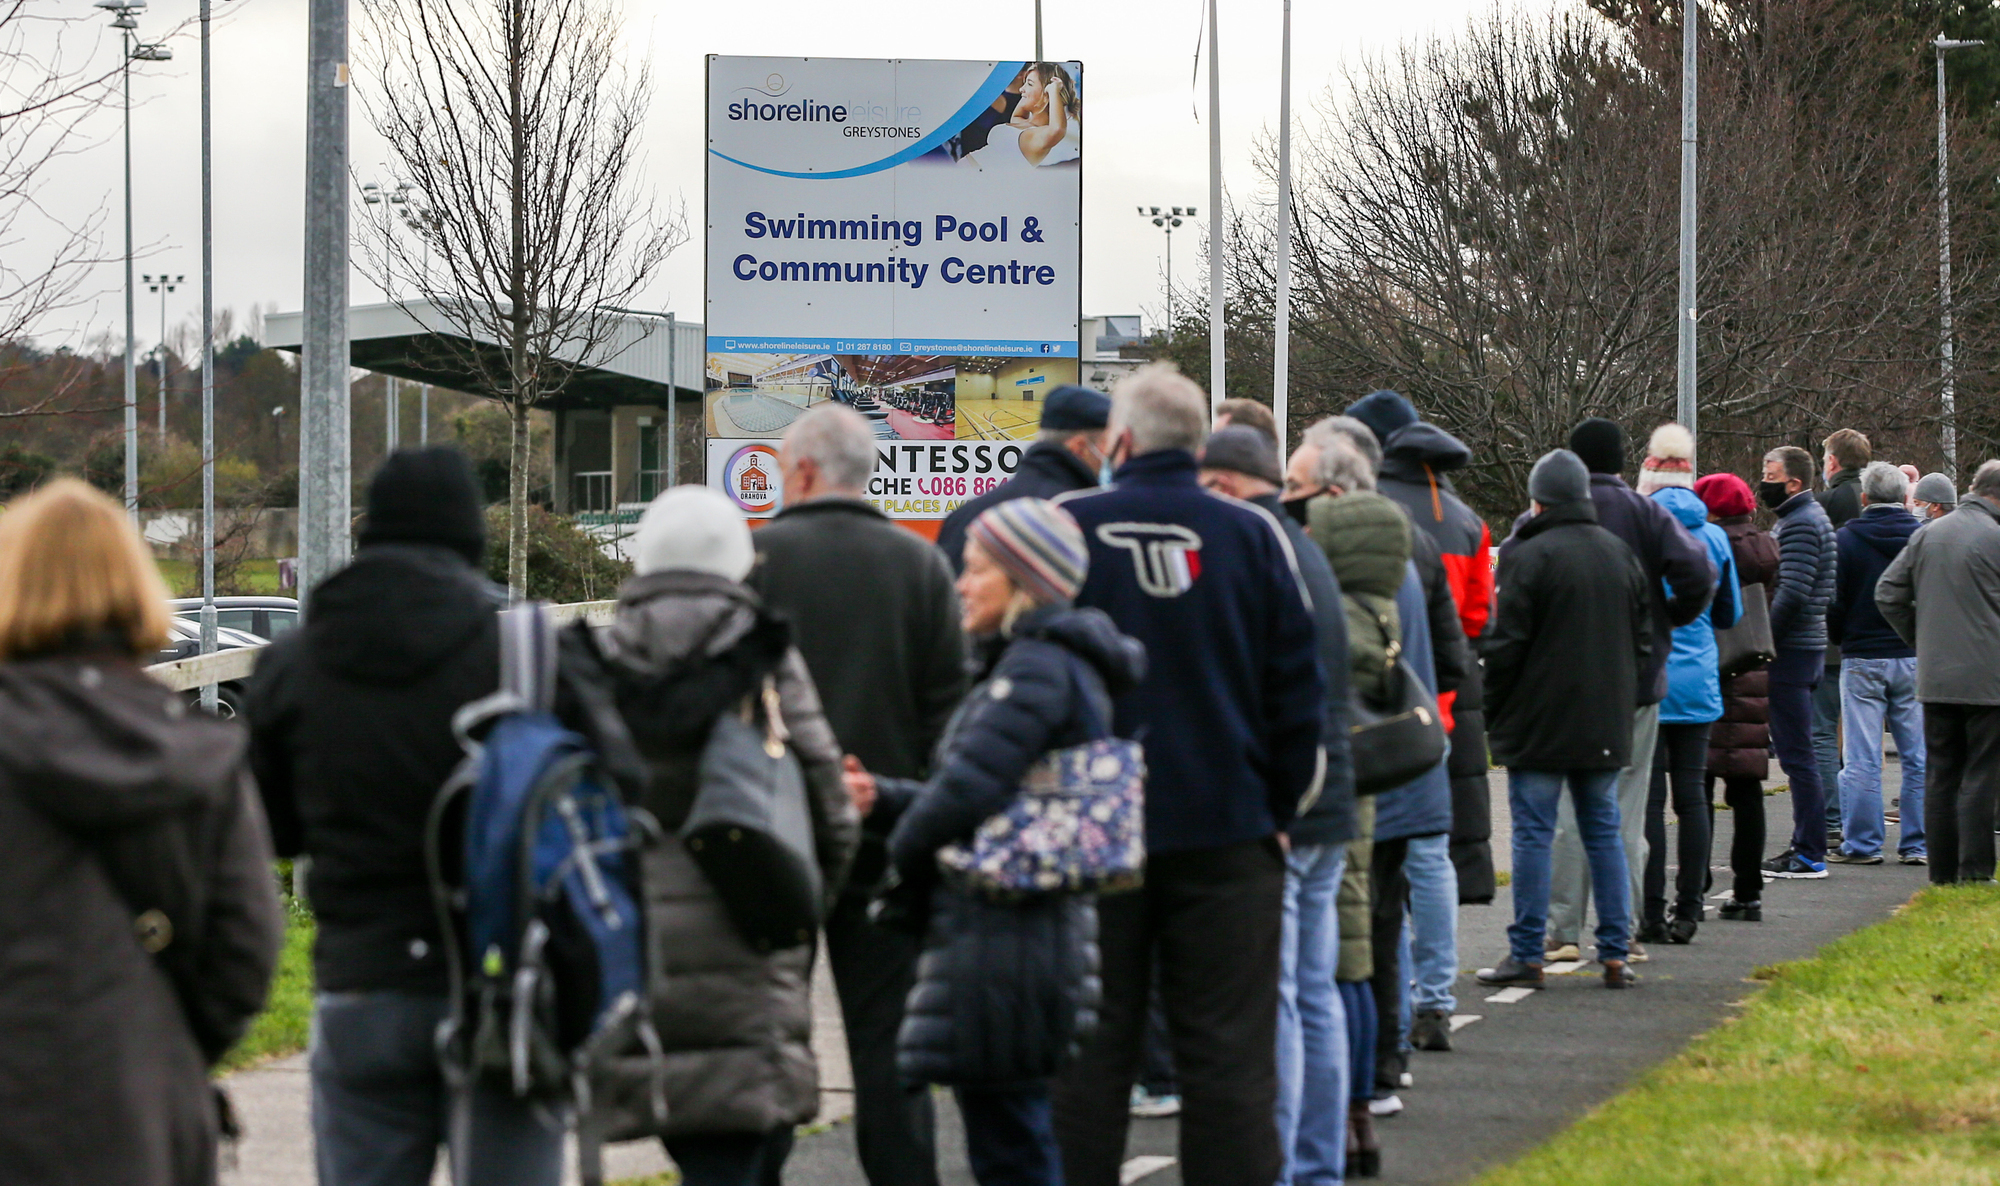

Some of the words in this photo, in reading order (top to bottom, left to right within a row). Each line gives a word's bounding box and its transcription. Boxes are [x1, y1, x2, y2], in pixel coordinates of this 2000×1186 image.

[843, 126, 921, 138] GREYSTONES
[744, 212, 922, 246] Swimming
[935, 215, 1008, 242] Pool
[1020, 216, 1044, 243] &
[732, 254, 929, 288] Community
[940, 257, 1056, 285] Centre
[737, 341, 830, 350] www.shorelineleisure.ie
[845, 342, 855, 350] 01
[857, 342, 871, 351] 287
[872, 342, 892, 351] 8180
[914, 345, 1033, 353] greystones@shorelineleisure.ie
[931, 477, 967, 496] 086
[885, 500, 941, 512] PLACES
